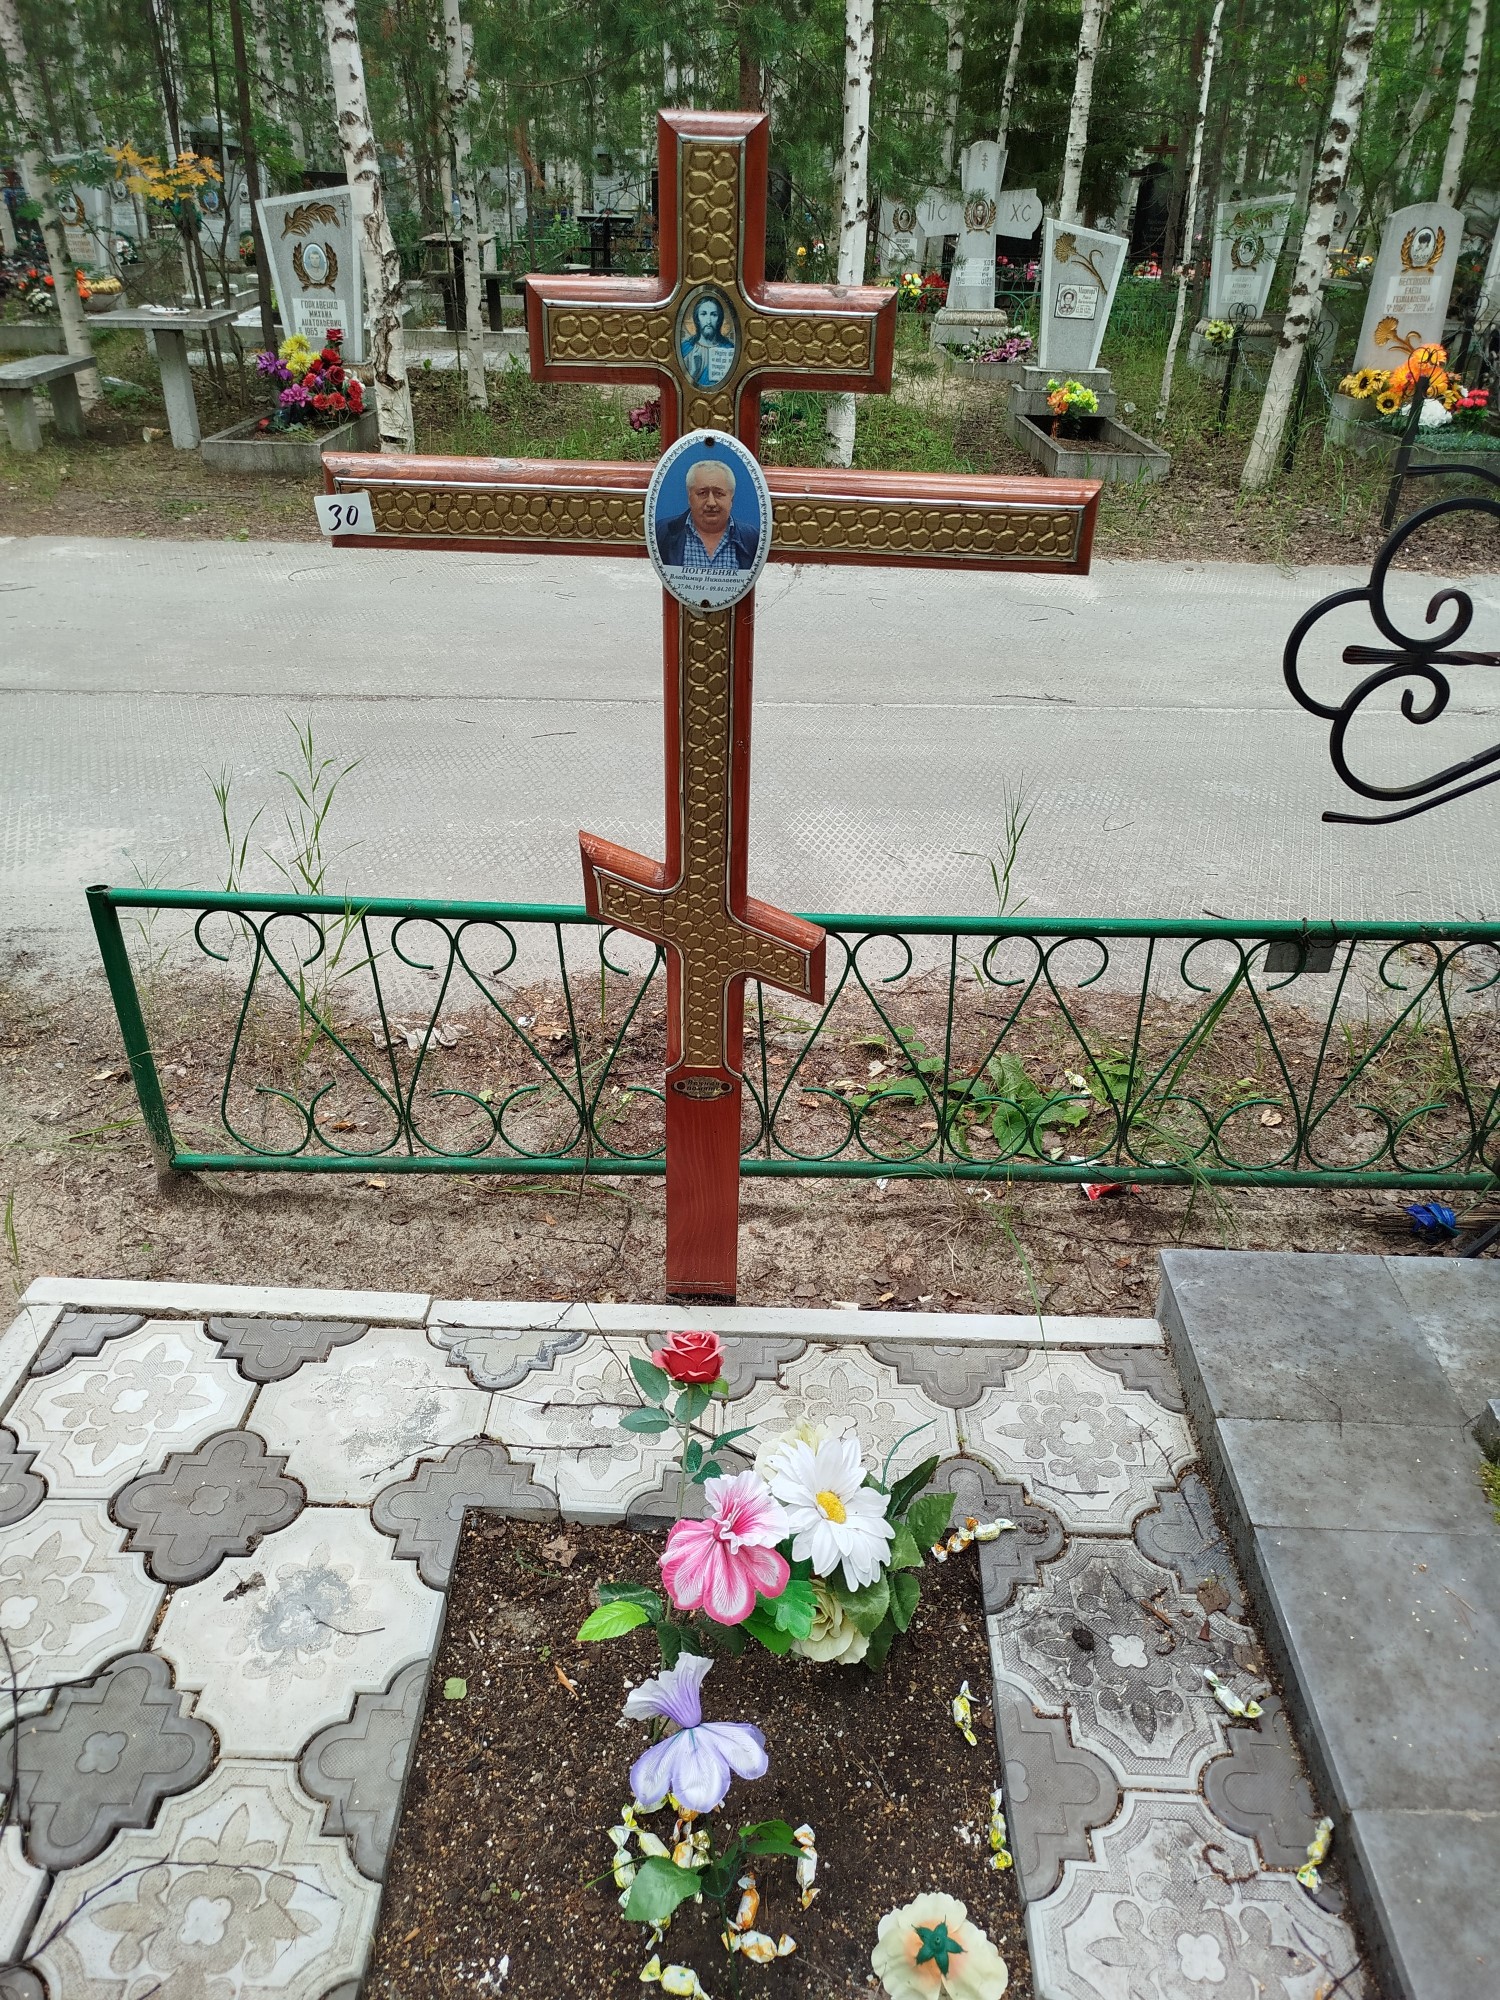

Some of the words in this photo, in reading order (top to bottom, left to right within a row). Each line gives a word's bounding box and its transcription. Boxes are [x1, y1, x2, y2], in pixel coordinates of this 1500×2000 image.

[300, 300, 338, 309] ГОРКАВЕНКО
[308, 310, 332, 318] МИХАИЛ
[301, 319, 342, 327] АНАТОЛЬЕВИЧ
[305, 328, 318, 336] 1965
[328, 504, 359, 531] 30
[681, 567, 739, 577] ПОГРЕБНЯК
[669, 574, 703, 583] Владимир
[704, 576, 745, 584] Николаевич
